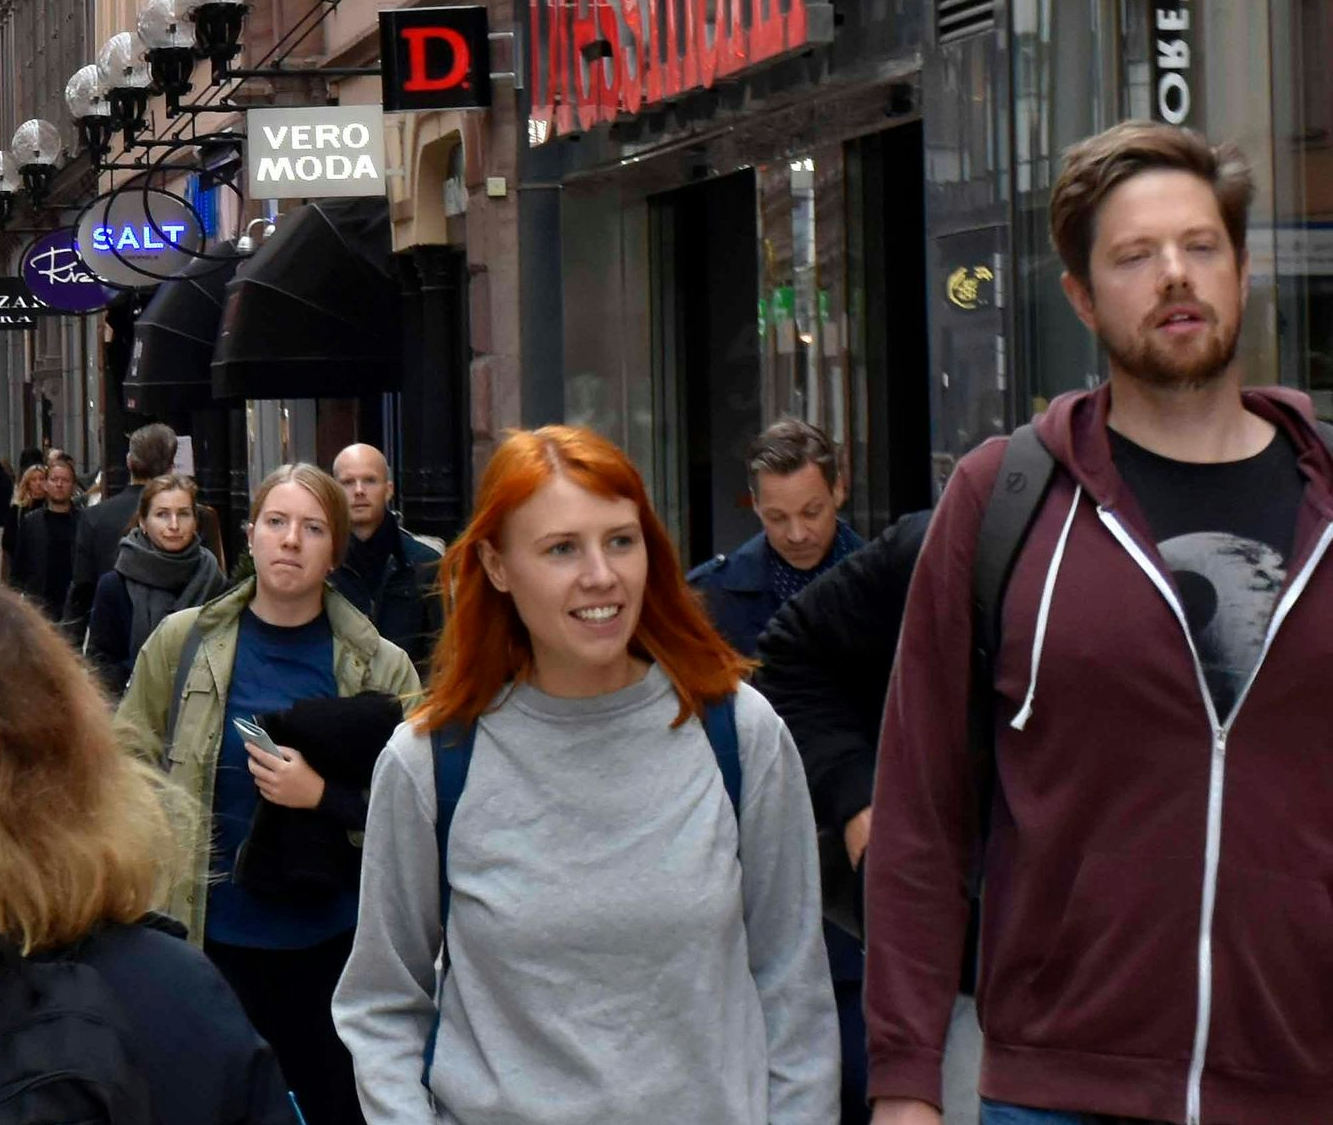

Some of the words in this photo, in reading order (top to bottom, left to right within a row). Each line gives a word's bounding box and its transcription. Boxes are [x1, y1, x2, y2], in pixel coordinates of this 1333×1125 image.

[262, 123, 369, 149] VERO
[256, 155, 379, 181] MODA
[92, 225, 185, 251] SALT
